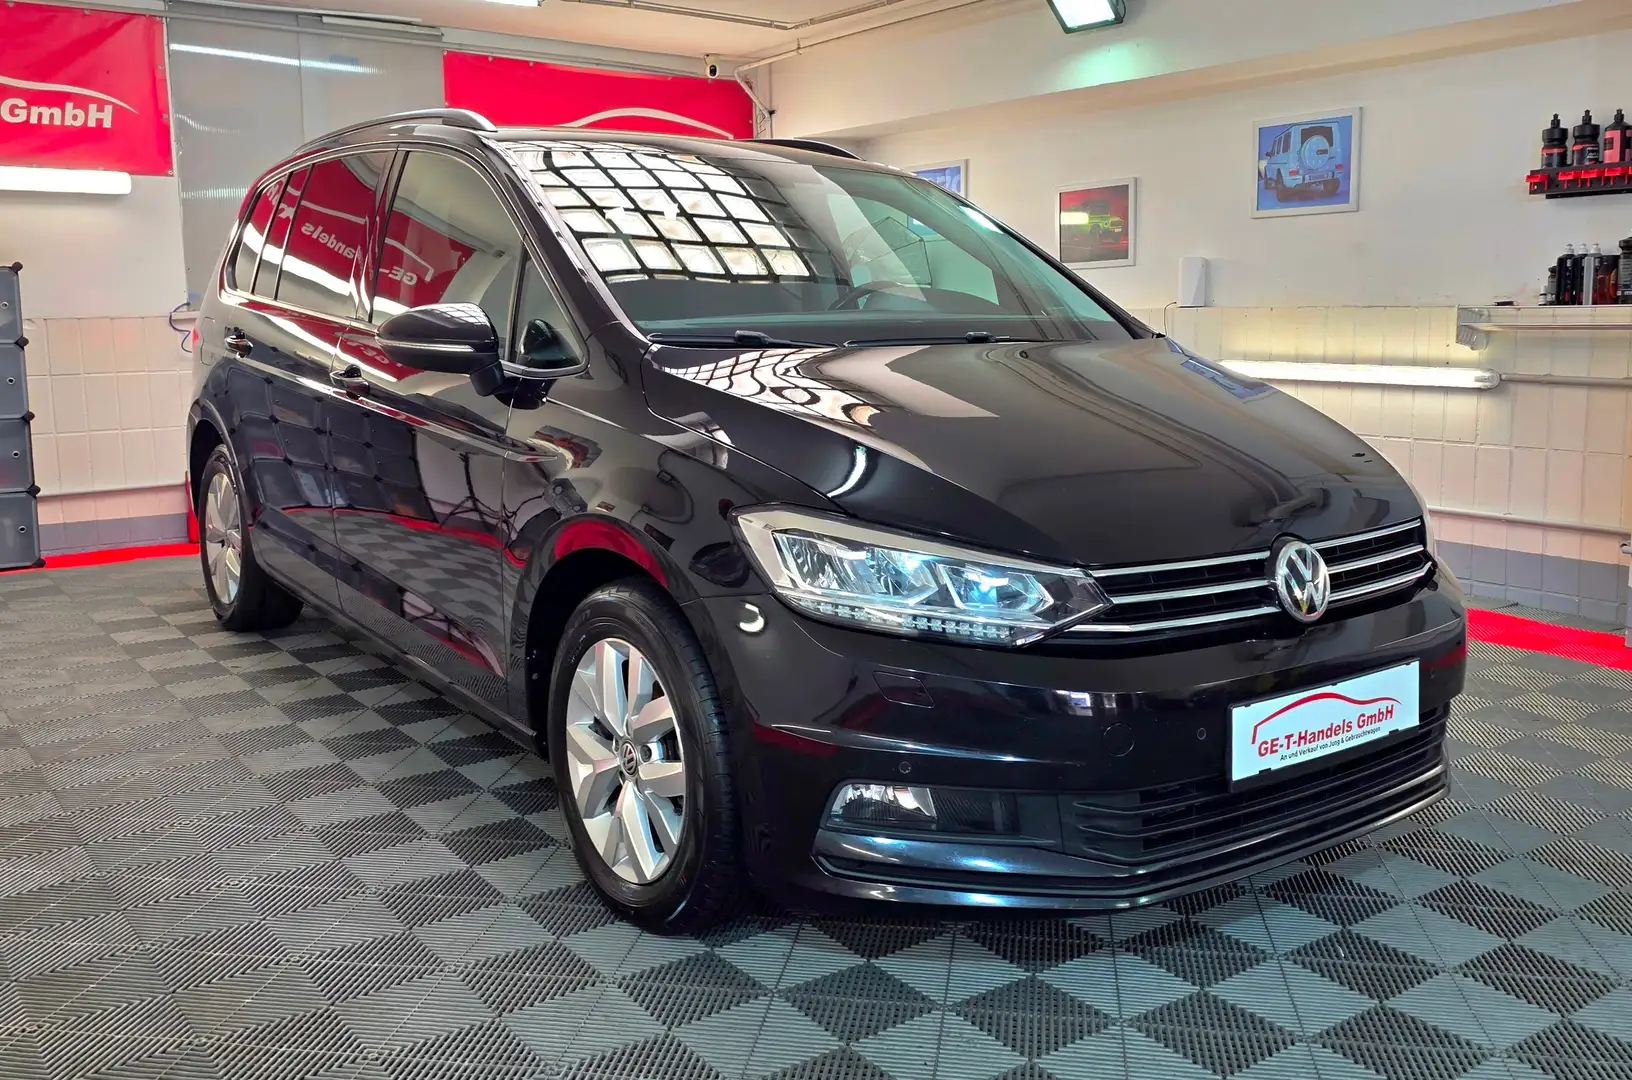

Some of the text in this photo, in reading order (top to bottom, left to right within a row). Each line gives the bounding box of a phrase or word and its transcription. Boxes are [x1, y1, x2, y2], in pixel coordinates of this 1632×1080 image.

[0, 98, 113, 128] GmbH
[1258, 704, 1394, 757] GE-T-Handels GmbH
[1289, 750, 1298, 759] und
[1299, 745, 1319, 756] Verkauf
[1329, 739, 1340, 748] Jung
[1345, 726, 1381, 743] Gebrauchtwagen
